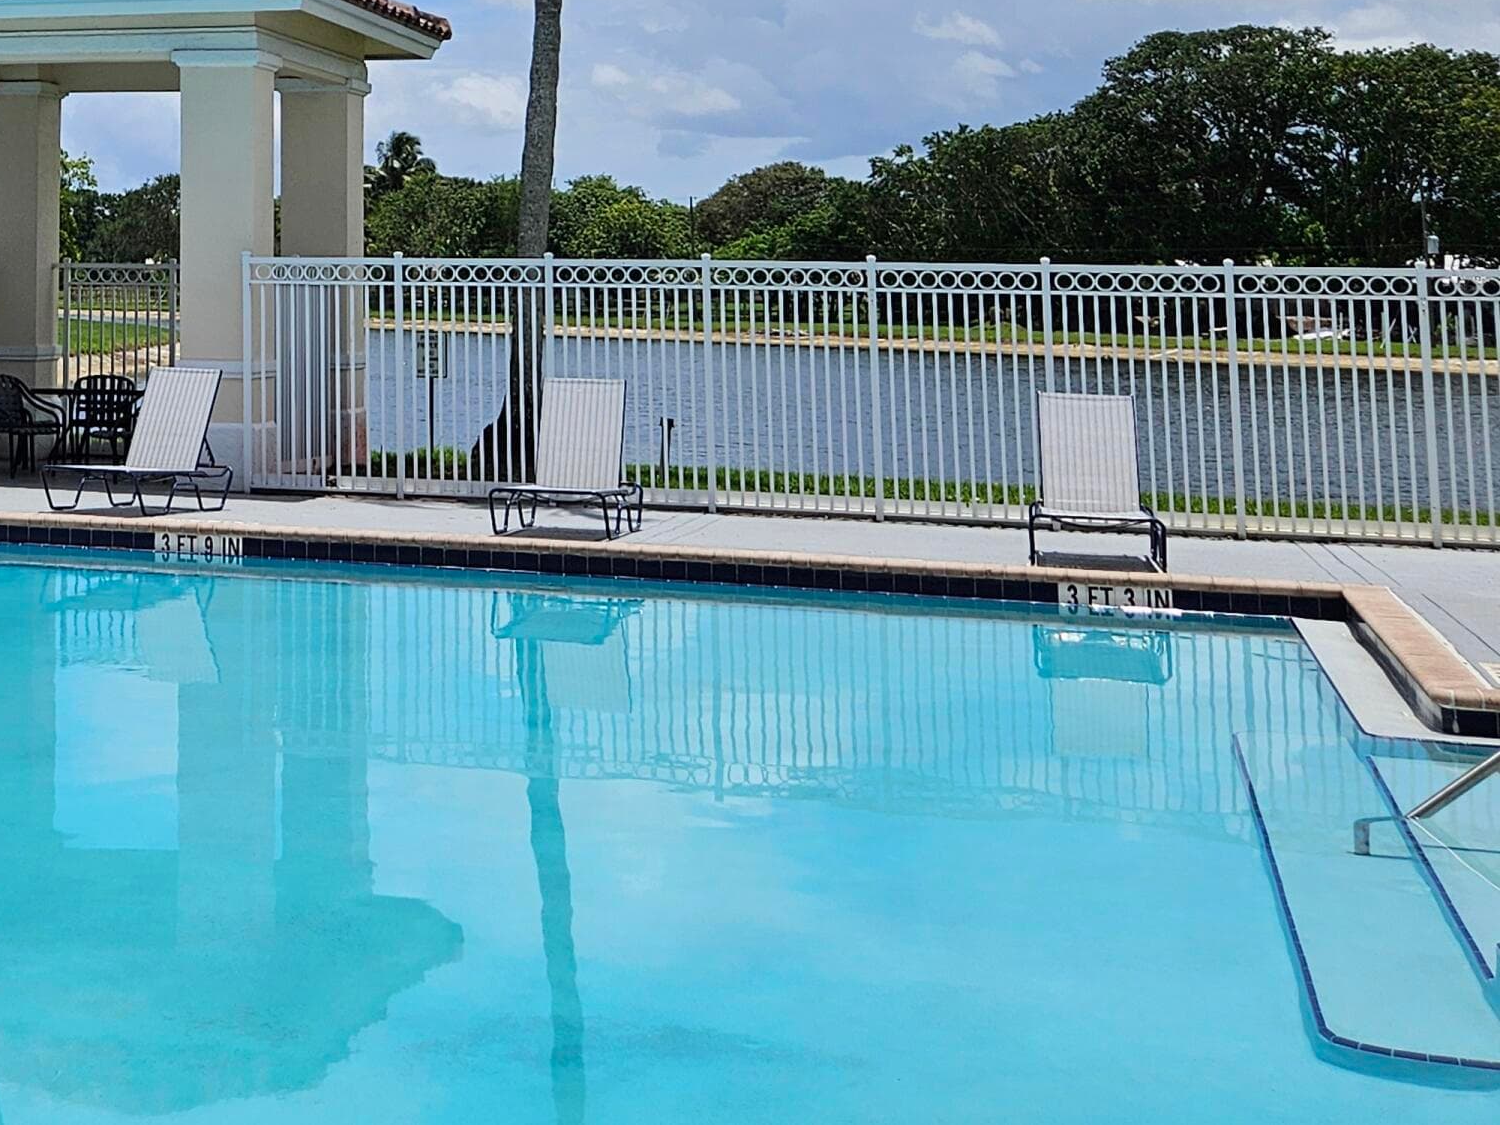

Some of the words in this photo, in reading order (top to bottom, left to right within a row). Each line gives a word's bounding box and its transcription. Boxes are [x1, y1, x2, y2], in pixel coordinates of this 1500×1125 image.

[161, 533, 171, 552] 3
[177, 535, 197, 554] FT
[204, 536, 214, 555] 9
[222, 536, 241, 557] IN
[1067, 584, 1079, 605] 3
[1087, 586, 1114, 606] FT
[1123, 588, 1136, 607] 3
[1146, 589, 1171, 609] IN
